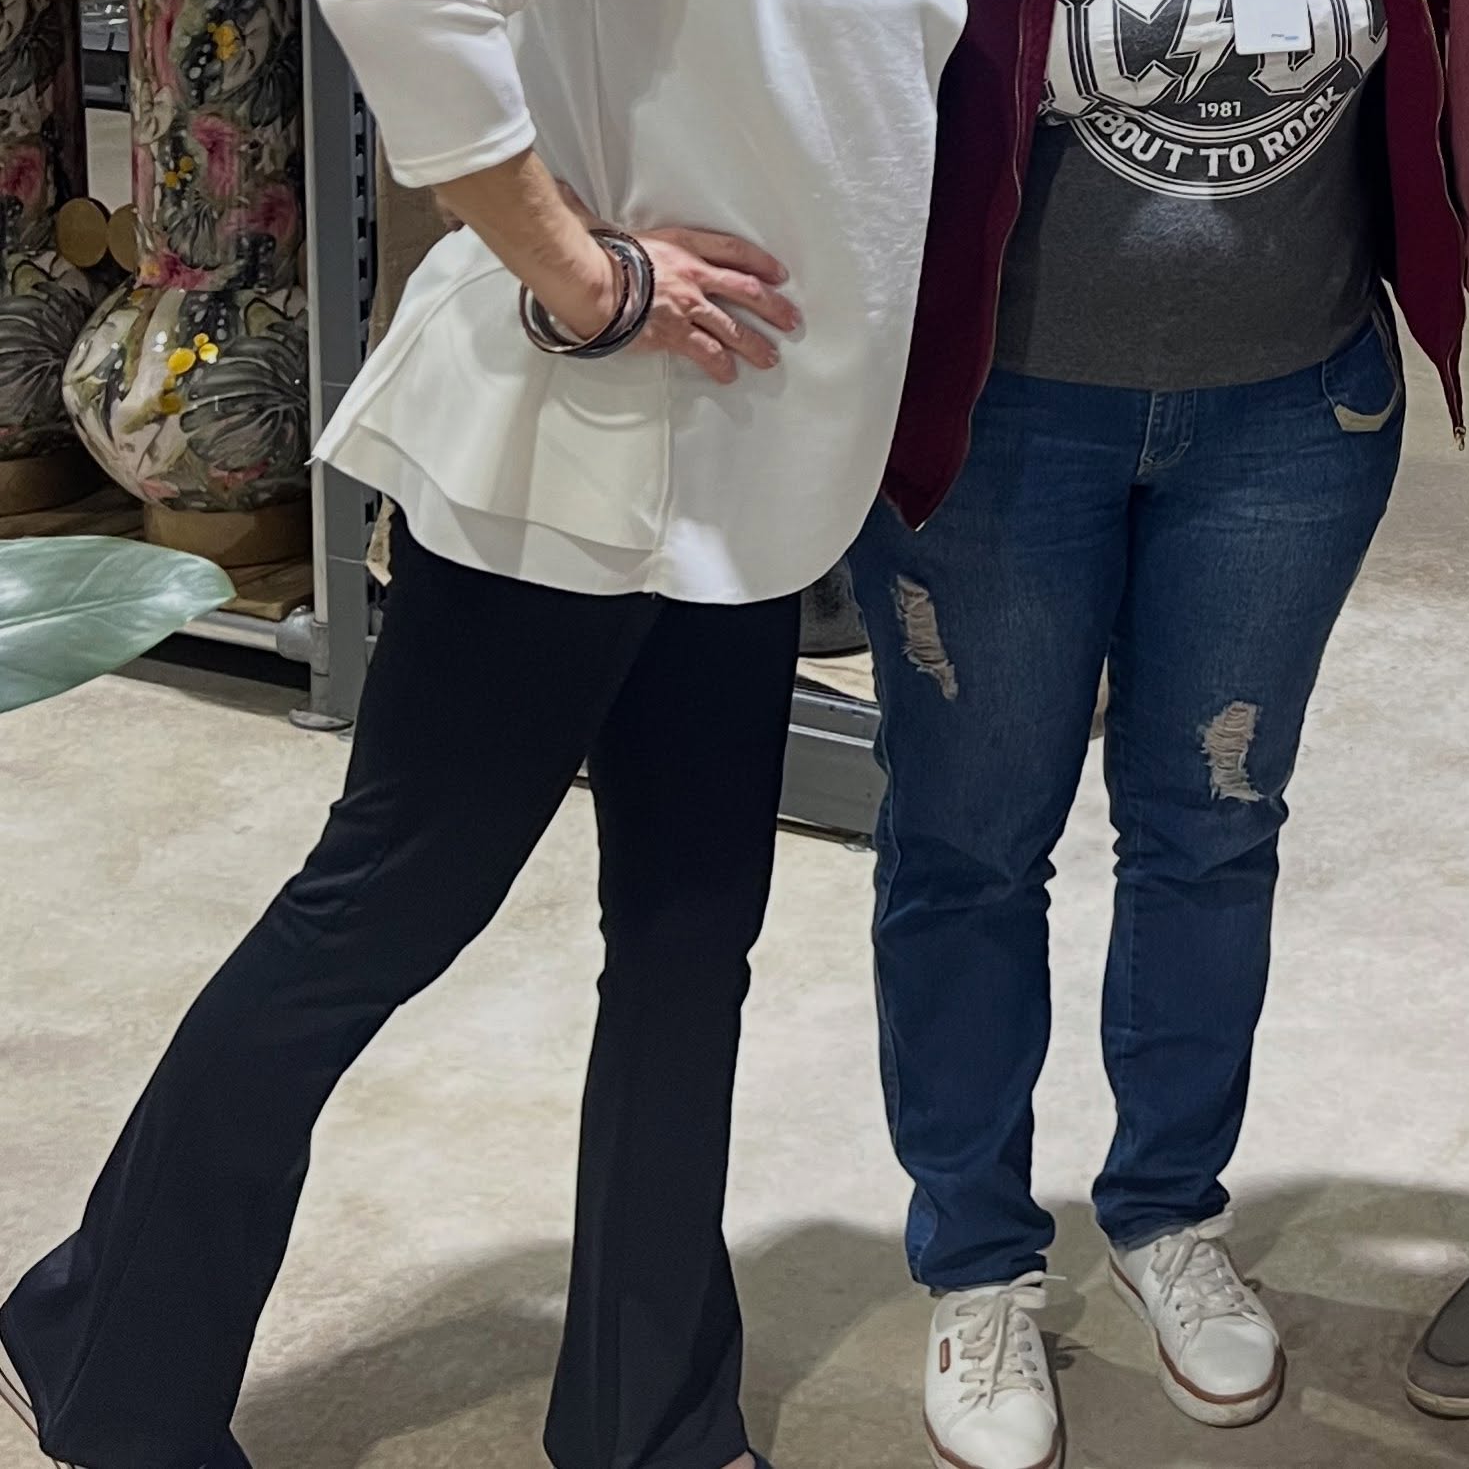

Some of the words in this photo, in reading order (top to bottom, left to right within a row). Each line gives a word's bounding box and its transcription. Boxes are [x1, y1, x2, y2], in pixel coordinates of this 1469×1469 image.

[1083, 111, 1194, 173] BOUT
[1199, 143, 1255, 177] TO
[1258, 86, 1347, 163] ROCK
[1197, 100, 1242, 119] 1981
